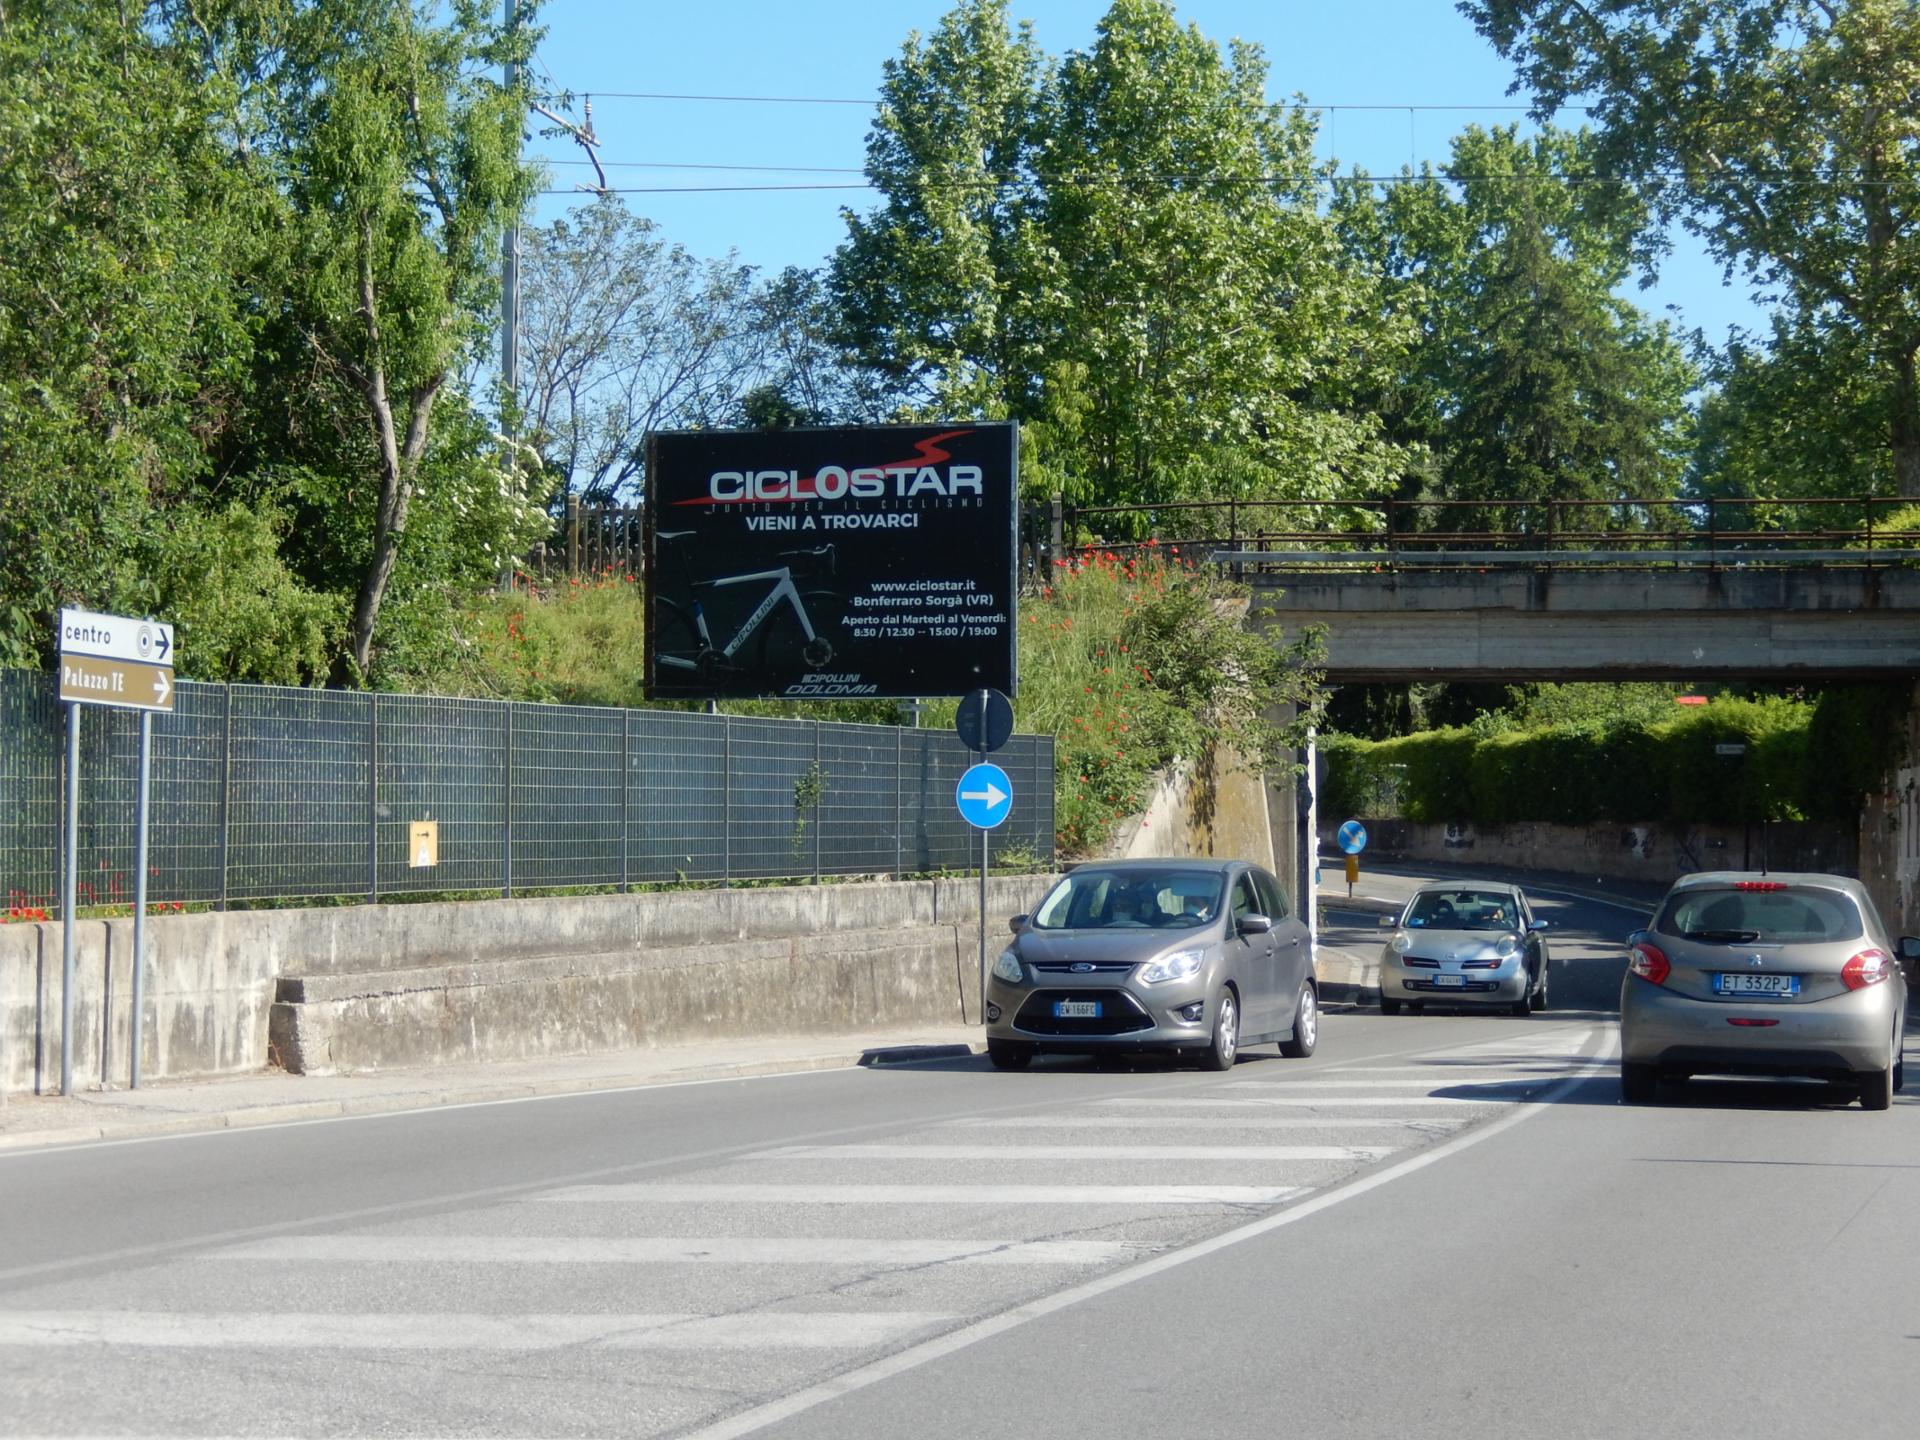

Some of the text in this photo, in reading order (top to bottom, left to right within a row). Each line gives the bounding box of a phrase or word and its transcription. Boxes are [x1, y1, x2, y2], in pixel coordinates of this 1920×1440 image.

[710, 465, 983, 500] CICLOSTAR
[711, 498, 983, 513] TUTTO PER IL CICLISMO
[746, 513, 919, 531] VIENI A TROVARCI
[871, 580, 976, 592] www.ciclostar.it
[854, 594, 994, 608] Bonferraro Sorgà (VR)
[731, 597, 774, 650] CIPOLLINI
[841, 615, 880, 626] Aperto
[882, 615, 900, 624] dal
[948, 614, 958, 624] al
[65, 625, 111, 644] centro
[854, 628, 876, 637] 8:30
[878, 627, 884, 638] /
[886, 627, 915, 637] 12:30
[929, 627, 958, 636] 15:00
[960, 626, 966, 637] /
[968, 627, 997, 636] 19:00
[64, 666, 124, 692] Palazzo TE
[785, 684, 878, 695] DOLOMIA
[1723, 975, 1790, 991] ET 332PJ
